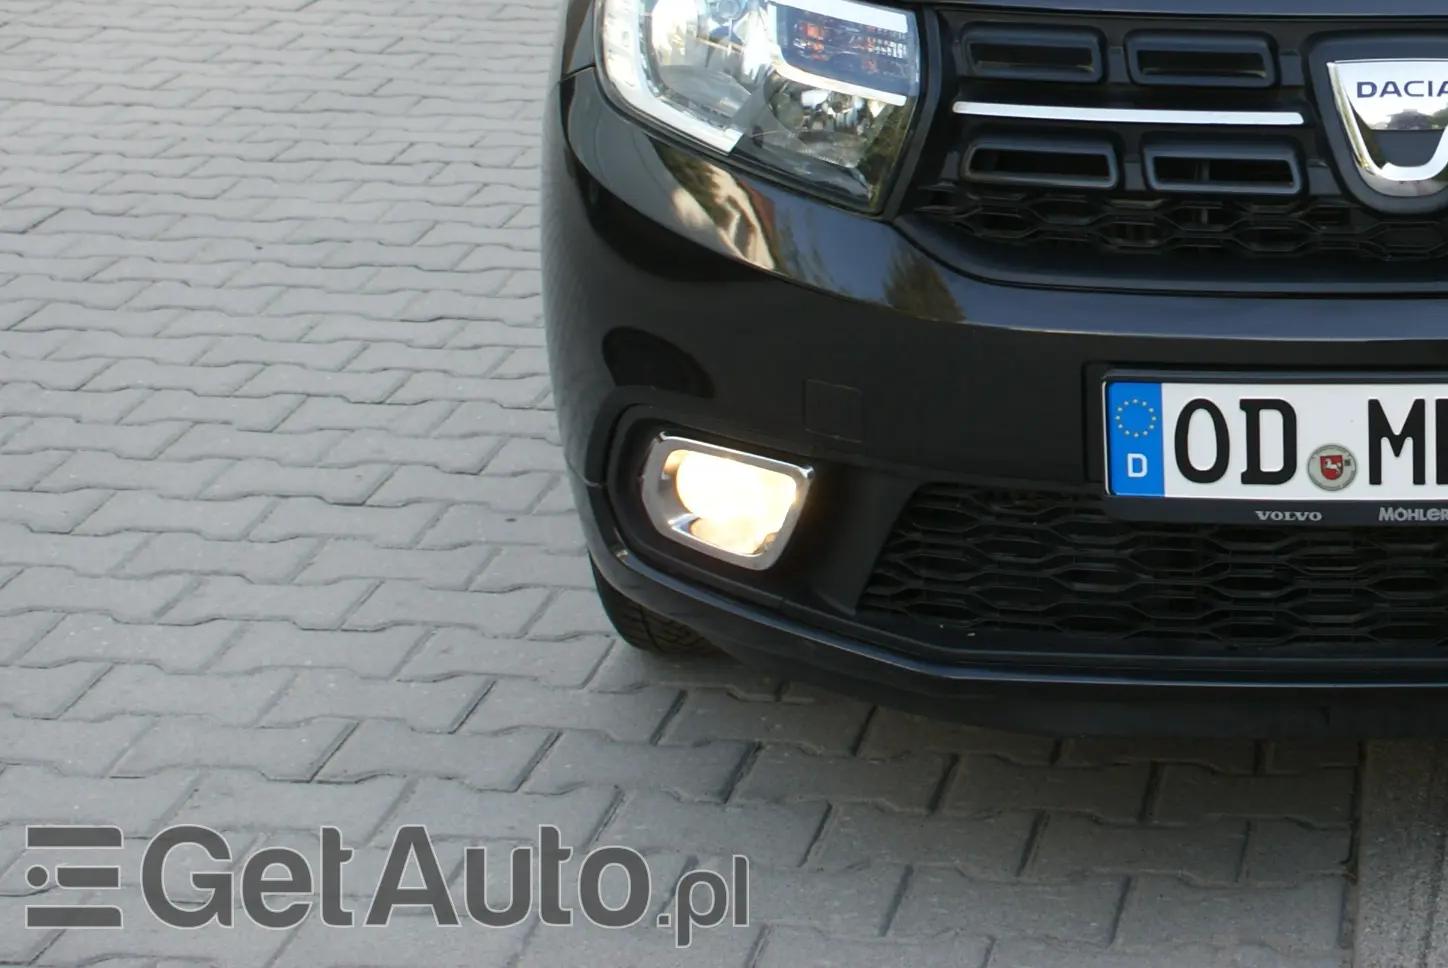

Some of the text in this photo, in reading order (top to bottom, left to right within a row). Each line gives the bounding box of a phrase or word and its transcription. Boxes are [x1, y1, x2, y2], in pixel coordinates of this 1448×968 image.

[1174, 398, 1298, 485] OD
[1127, 453, 1148, 478] D
[1254, 510, 1323, 522] VOLVO
